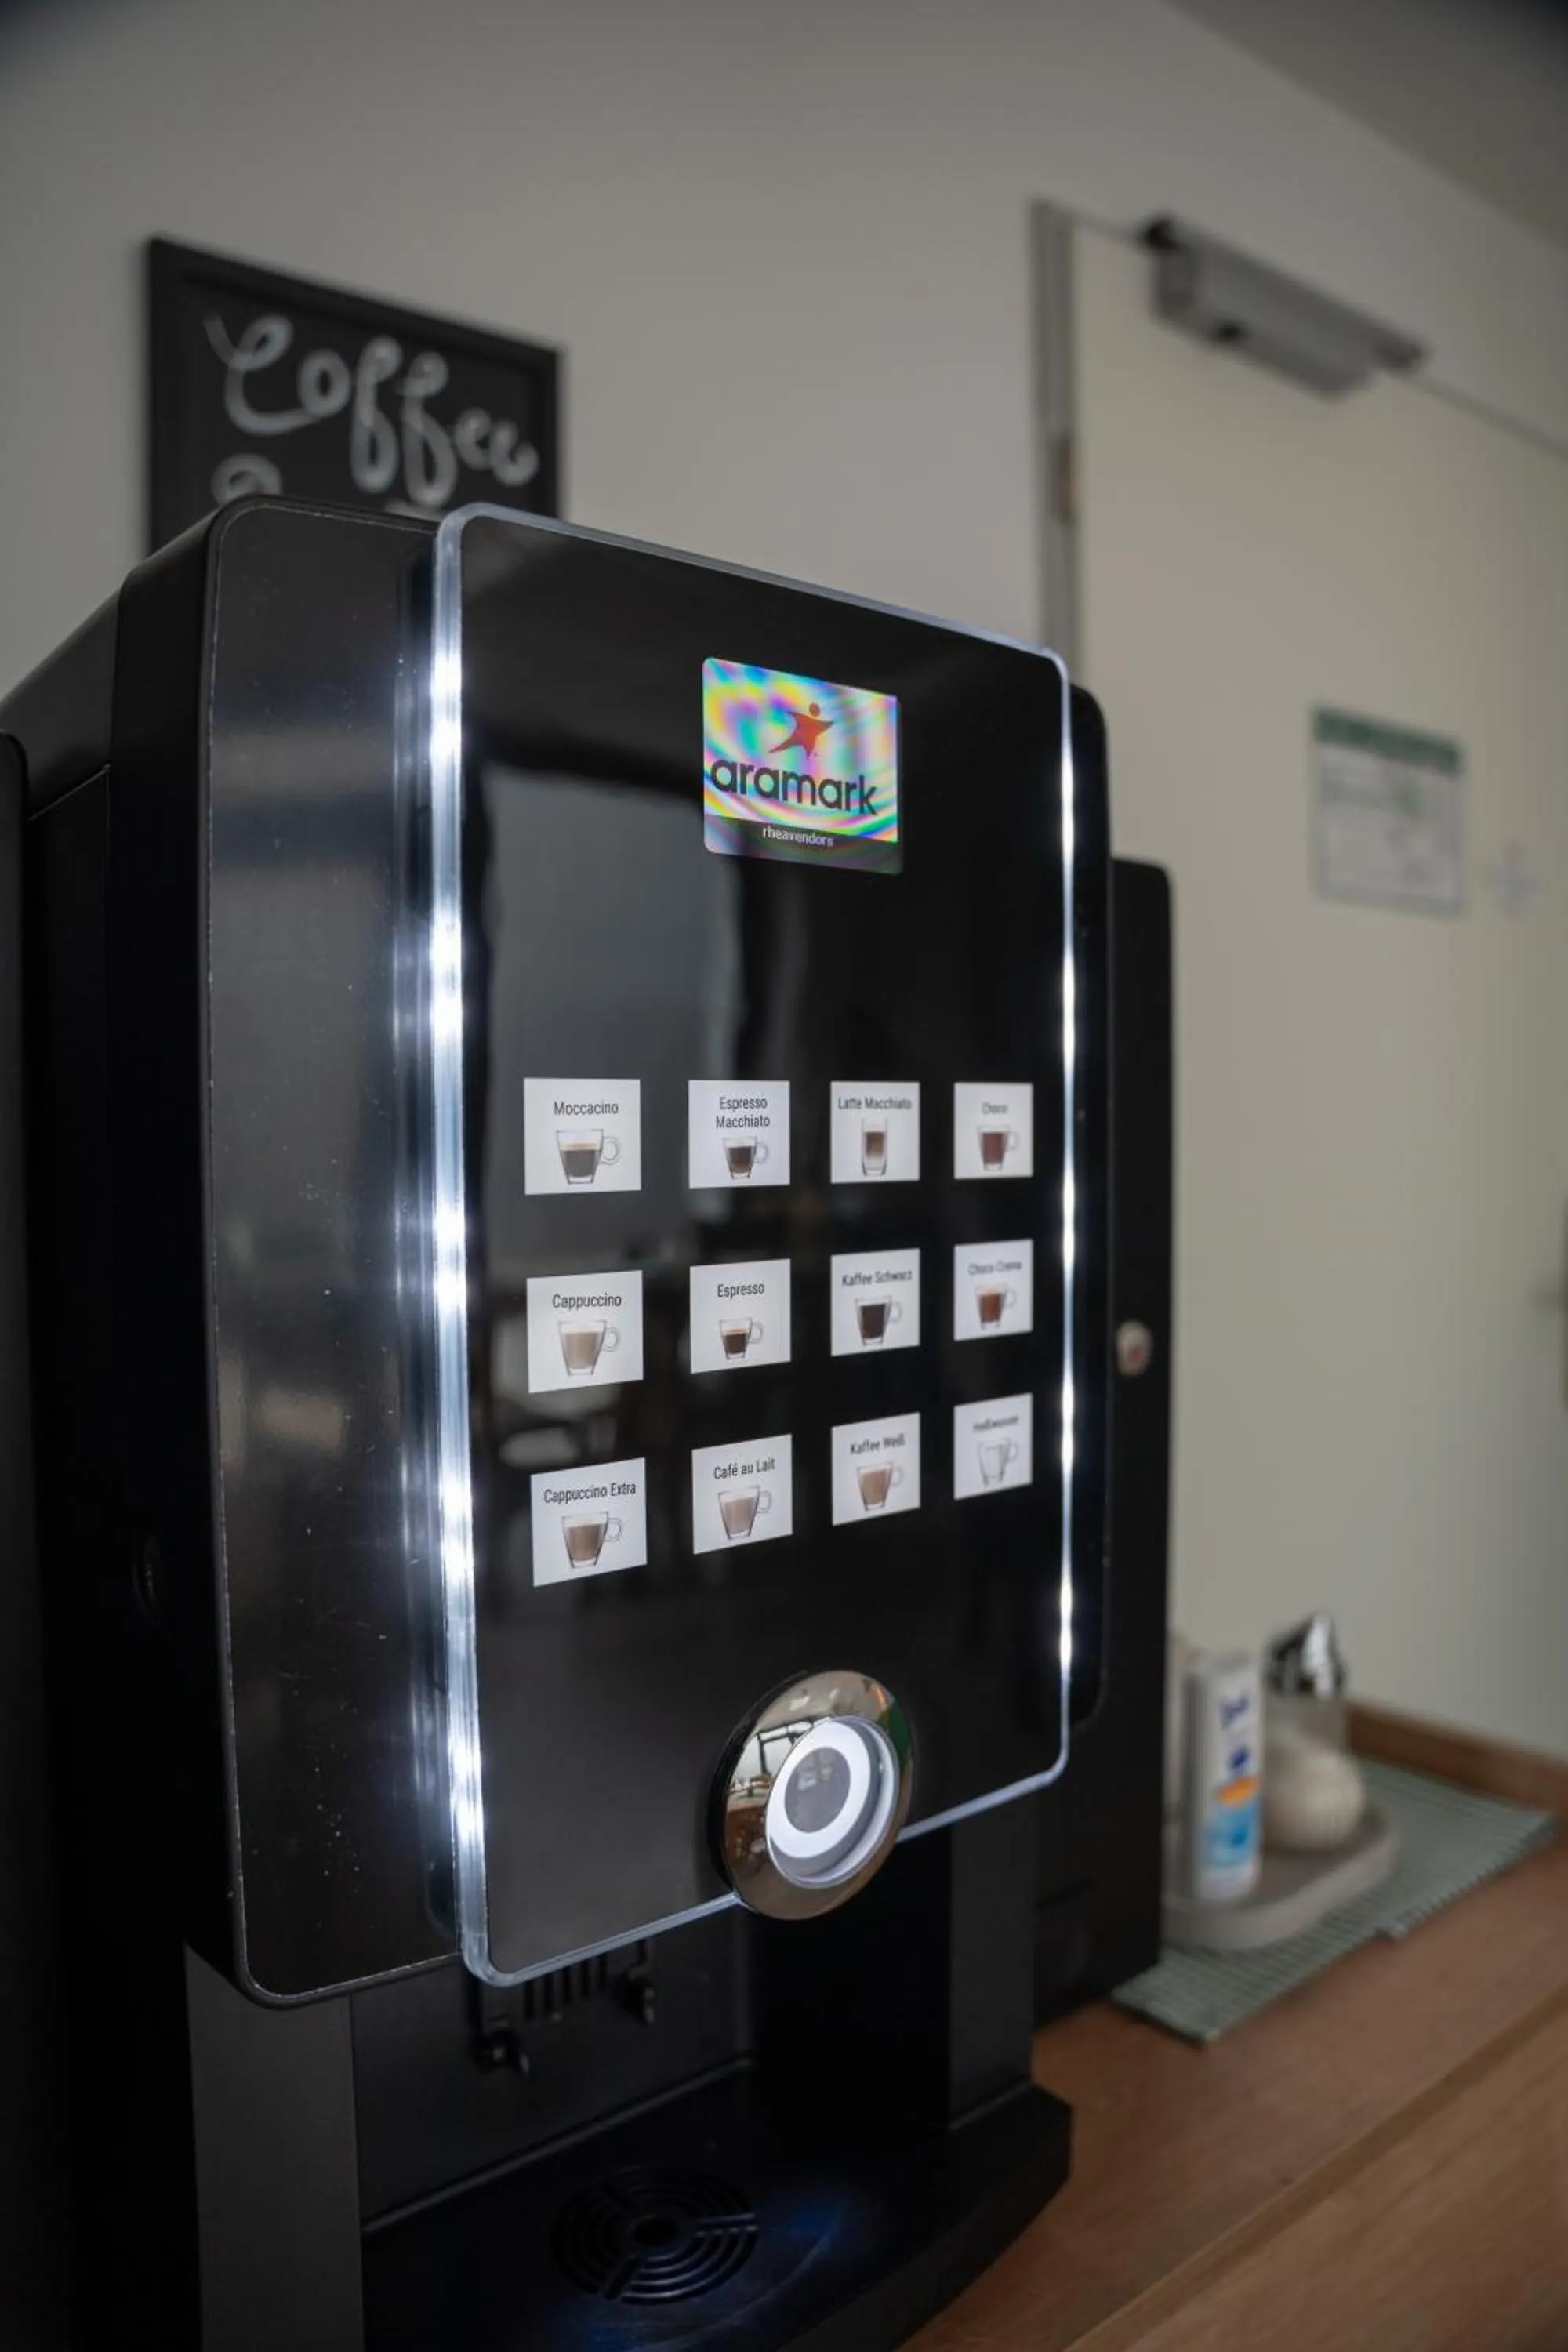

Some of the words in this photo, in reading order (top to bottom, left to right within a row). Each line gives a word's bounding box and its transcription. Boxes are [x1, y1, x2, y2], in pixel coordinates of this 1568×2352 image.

[710, 758, 878, 816] aramark
[762, 825, 834, 847] rheavendors
[554, 1100, 619, 1116] Moccacino
[719, 1096, 768, 1112] Espresso
[838, 1097, 862, 1109] Latte
[865, 1096, 912, 1110] Macchiato
[716, 1114, 770, 1129] Macchiato
[842, 1272, 873, 1287] Kaffee
[875, 1269, 913, 1283] Schwarz
[717, 1283, 765, 1298] Espresso
[552, 1292, 622, 1310] Cappuccino
[851, 1438, 880, 1455] Kaffee
[714, 1462, 738, 1479] Café
[741, 1463, 753, 1475] au
[756, 1457, 775, 1472] Lait
[543, 1484, 608, 1504] Cappuccino
[611, 1482, 637, 1497] Extra
